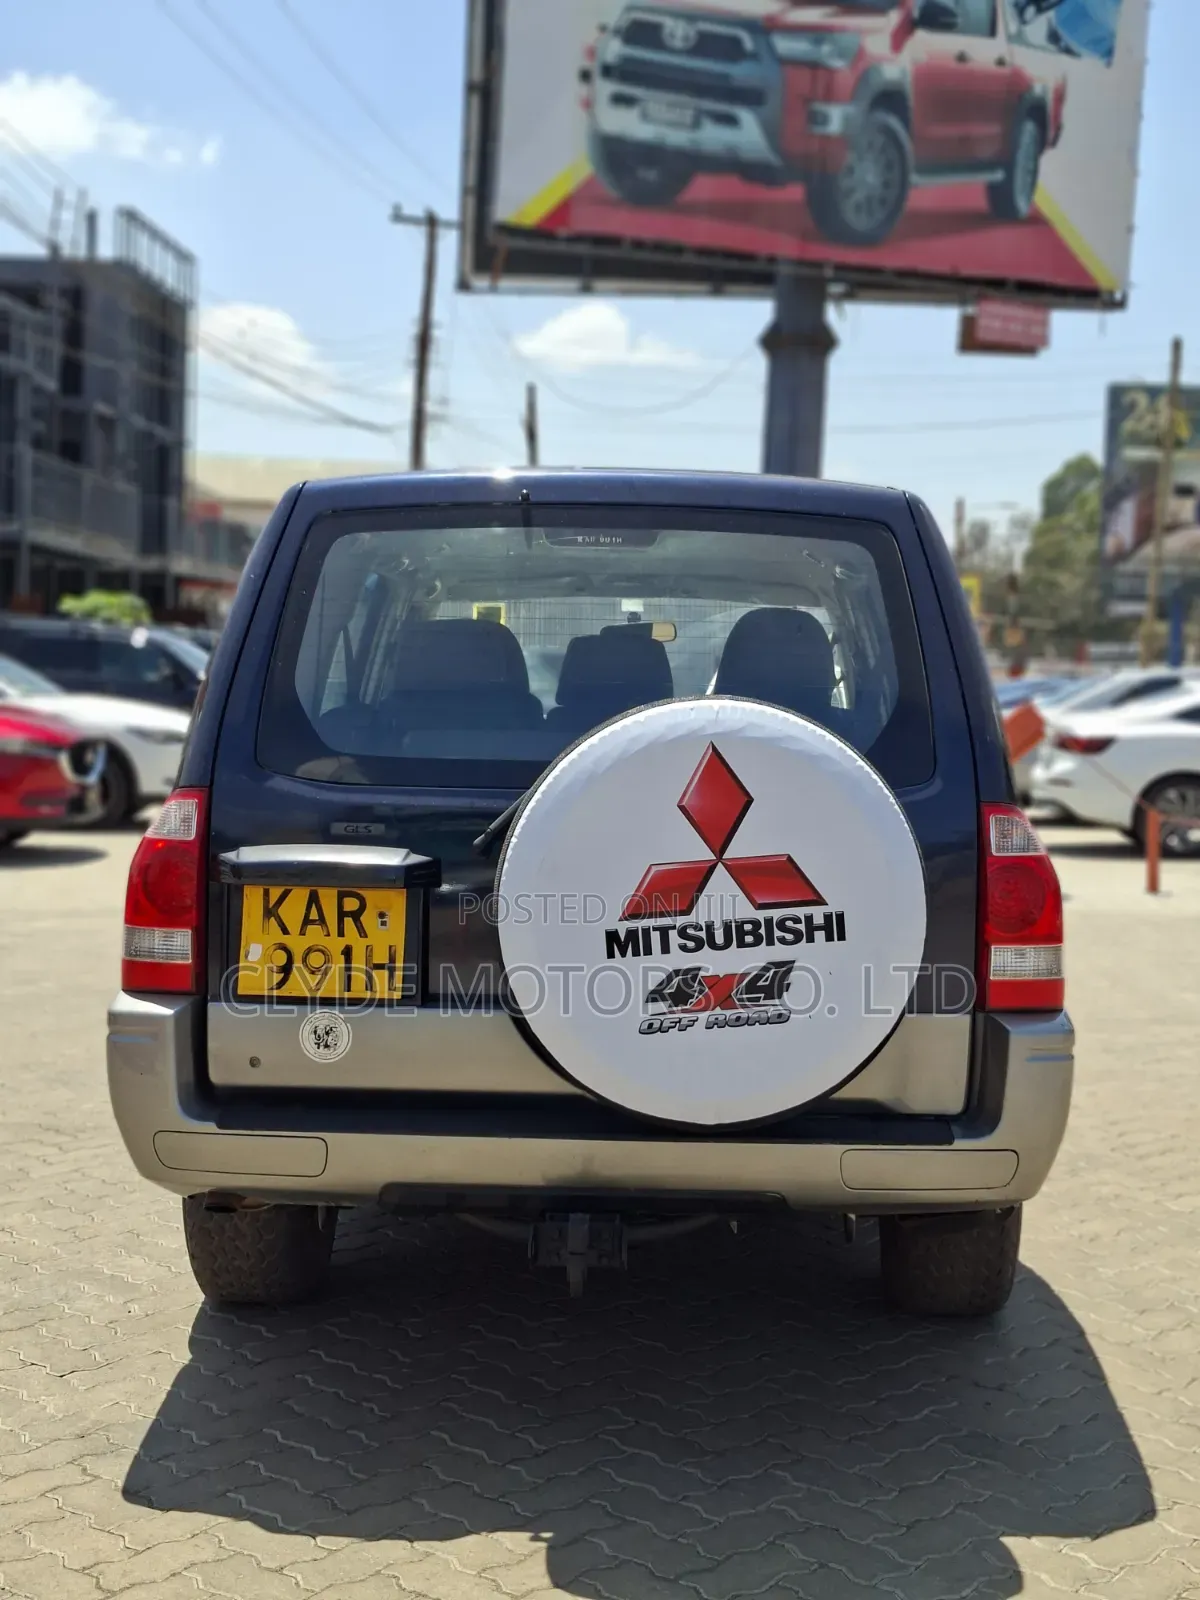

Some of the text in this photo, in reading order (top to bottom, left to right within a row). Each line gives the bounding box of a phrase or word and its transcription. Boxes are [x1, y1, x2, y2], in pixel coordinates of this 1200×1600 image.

[344, 825, 372, 834] GLS
[262, 888, 368, 938] KAR
[605, 911, 846, 959] MITSUBISHI
[264, 943, 396, 992] 991H
[638, 1009, 791, 1035] OFF ROAD
